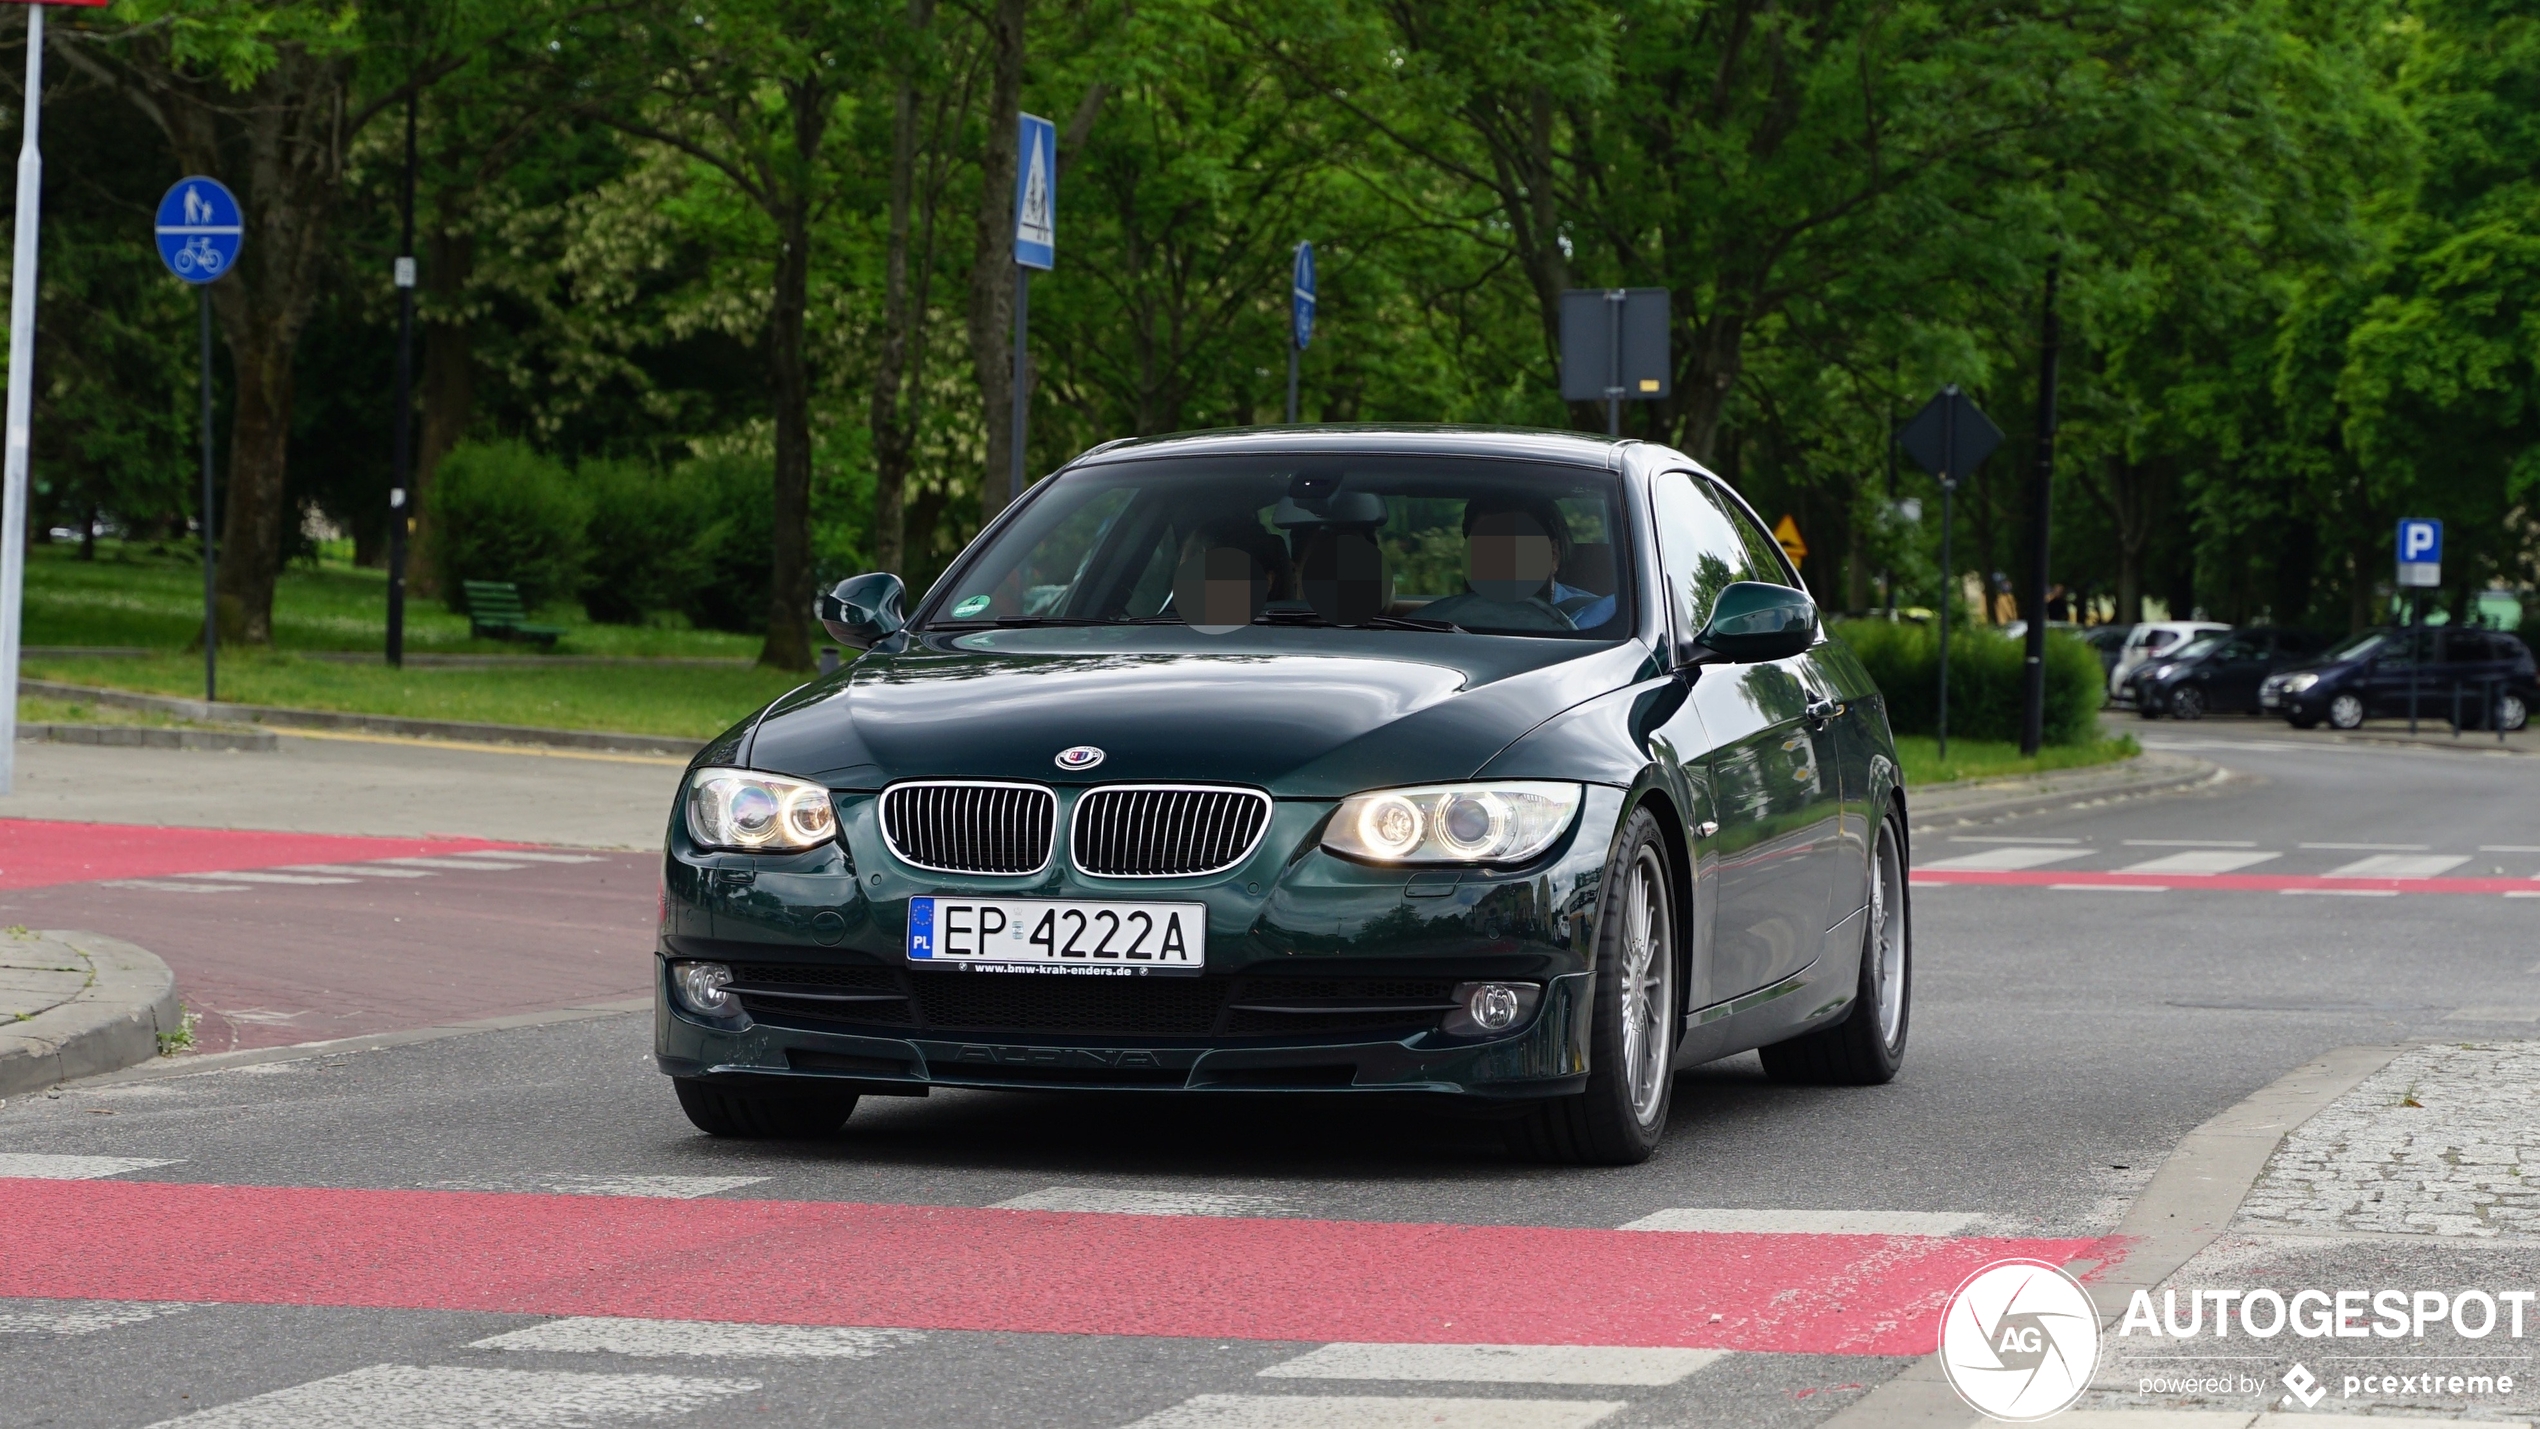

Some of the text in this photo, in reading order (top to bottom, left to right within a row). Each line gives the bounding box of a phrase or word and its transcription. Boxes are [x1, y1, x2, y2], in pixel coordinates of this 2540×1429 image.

[2406, 523, 2434, 560] P
[913, 935, 930, 950] PL
[945, 906, 1187, 960] EP 4222A
[974, 963, 1132, 977] www.bmw-krah-enders.de
